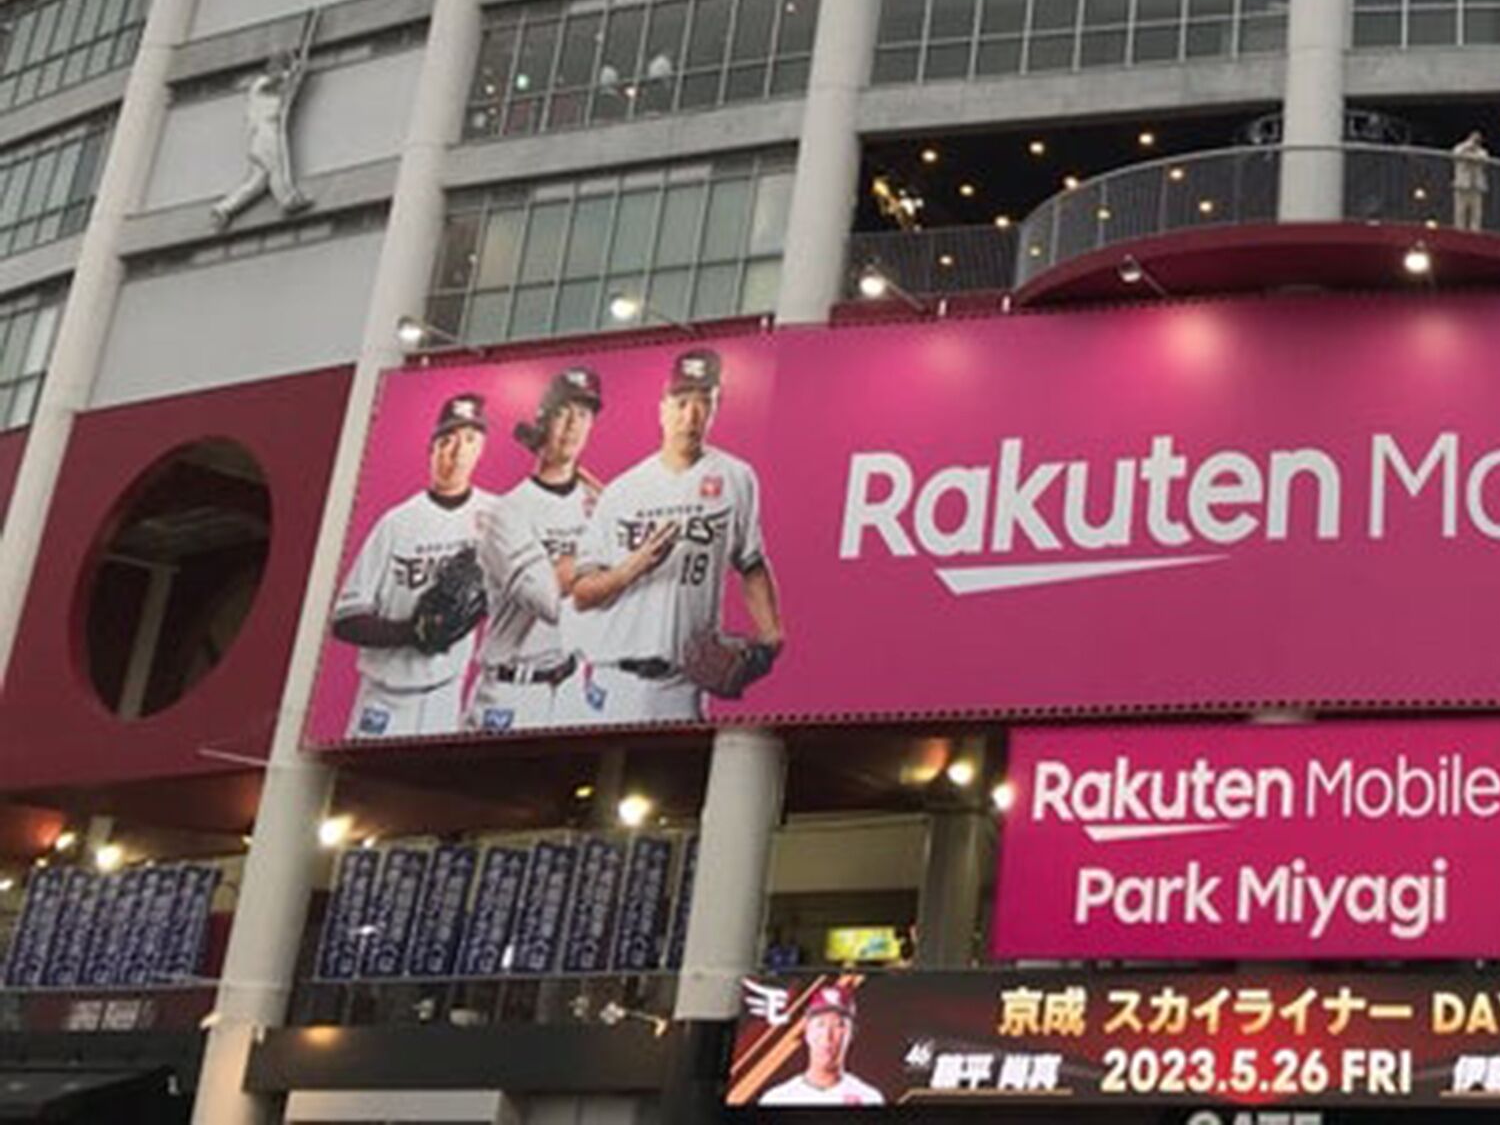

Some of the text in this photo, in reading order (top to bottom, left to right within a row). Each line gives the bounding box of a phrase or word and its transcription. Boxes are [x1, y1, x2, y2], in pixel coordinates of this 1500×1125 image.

[840, 436, 1339, 559] Rakuten
[679, 553, 709, 586] 18
[1032, 757, 1294, 820] Rakuten
[1075, 858, 1448, 939] Park Miyagi
[998, 986, 1087, 1036] 京成
[1103, 987, 1413, 1035] スカイライナー
[1101, 1048, 1329, 1094] 2023.5.26
[1341, 1048, 1412, 1094] FRI
